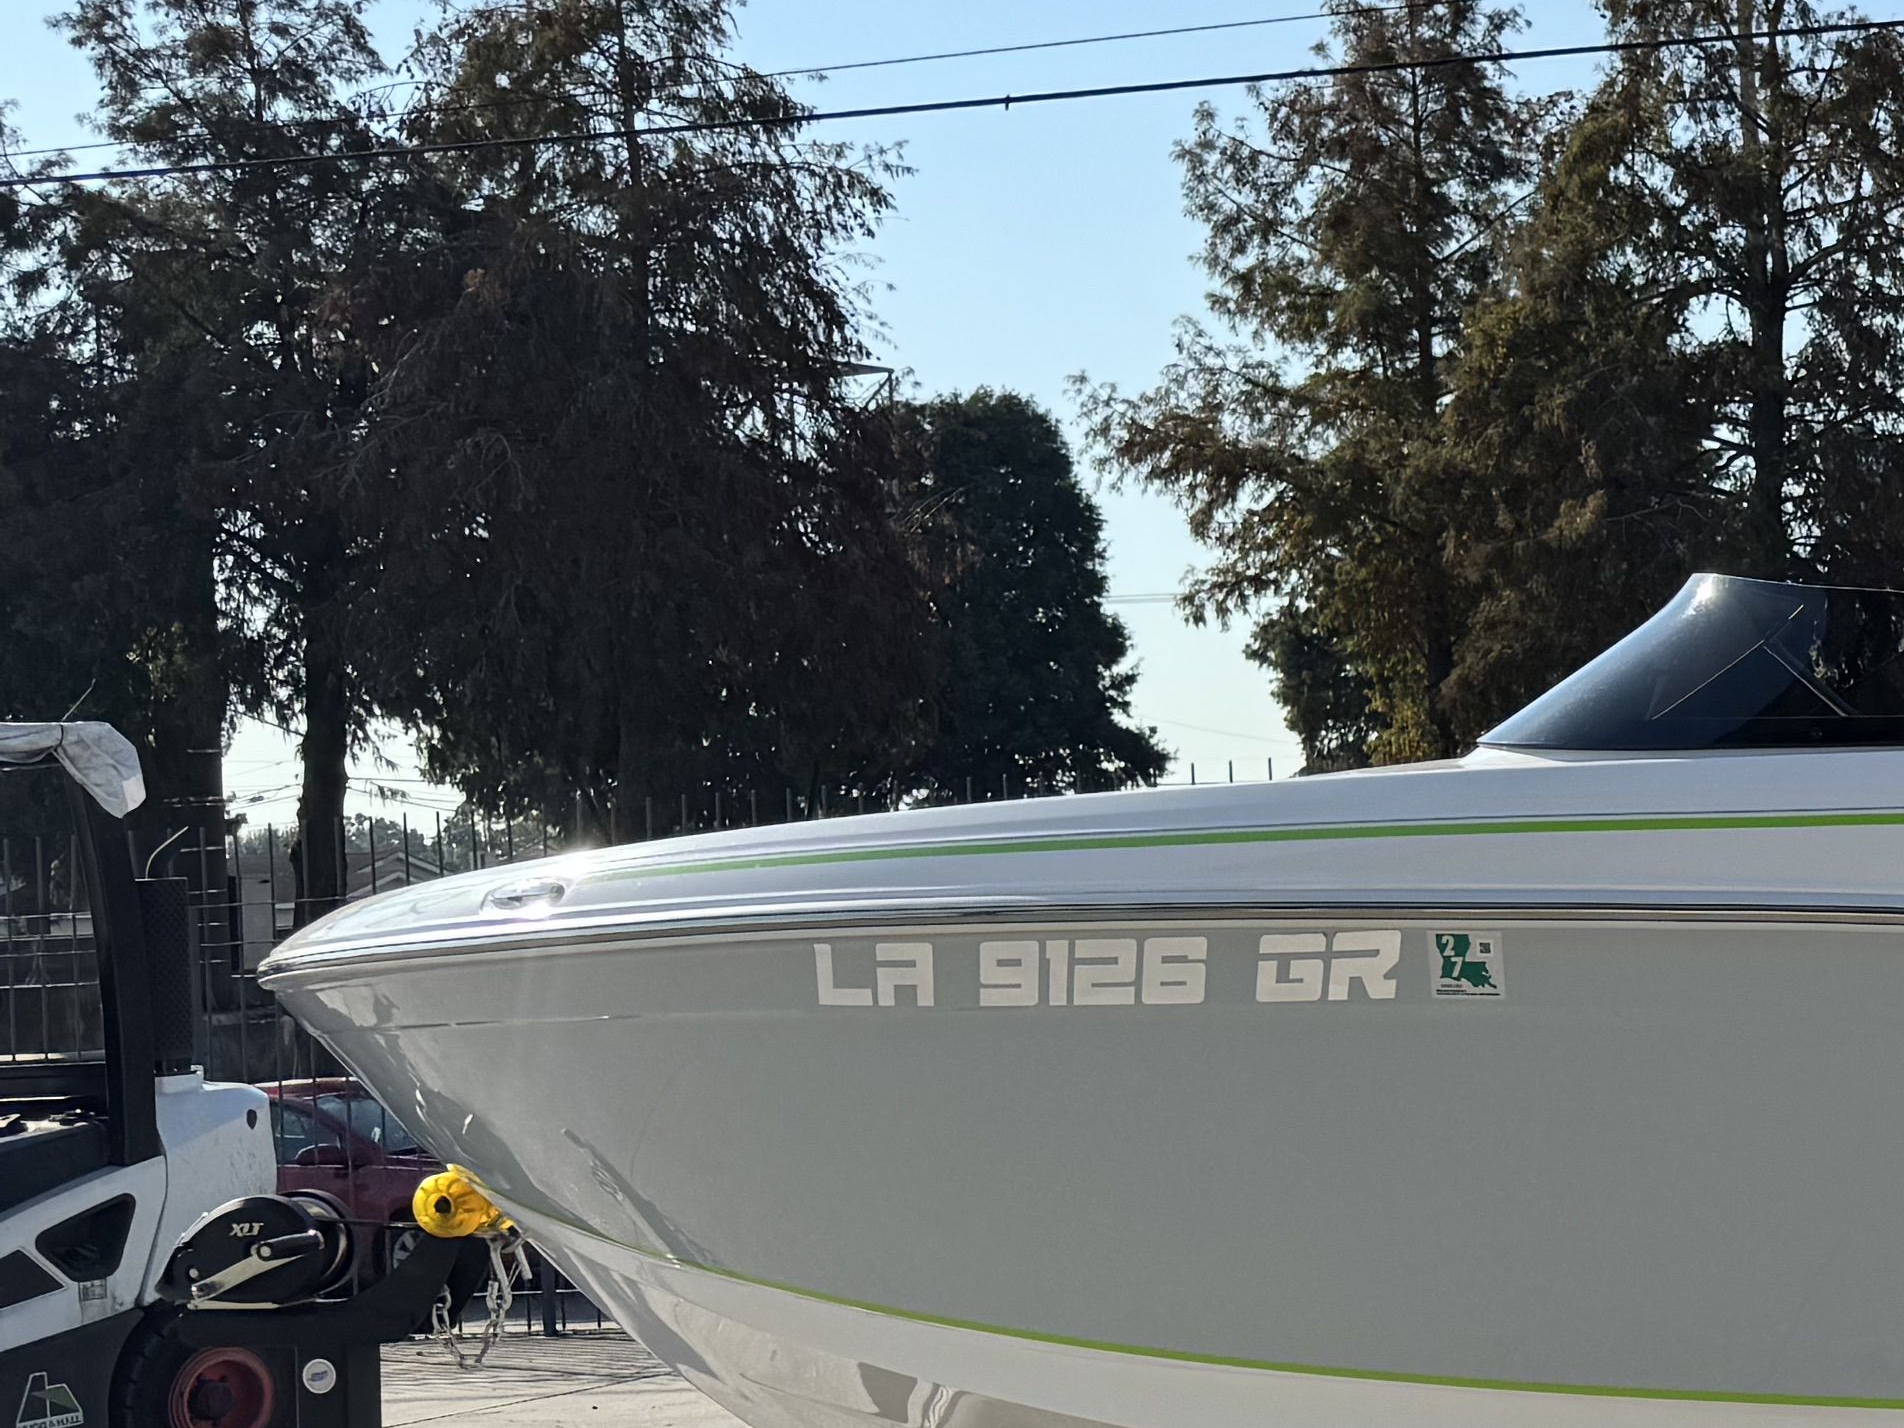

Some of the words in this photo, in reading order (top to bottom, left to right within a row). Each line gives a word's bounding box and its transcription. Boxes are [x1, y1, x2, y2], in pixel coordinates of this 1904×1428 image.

[813, 942, 934, 1007] LA
[979, 936, 1207, 1007] 9126
[1256, 930, 1401, 1002] GR
[229, 1222, 265, 1237] XLT
